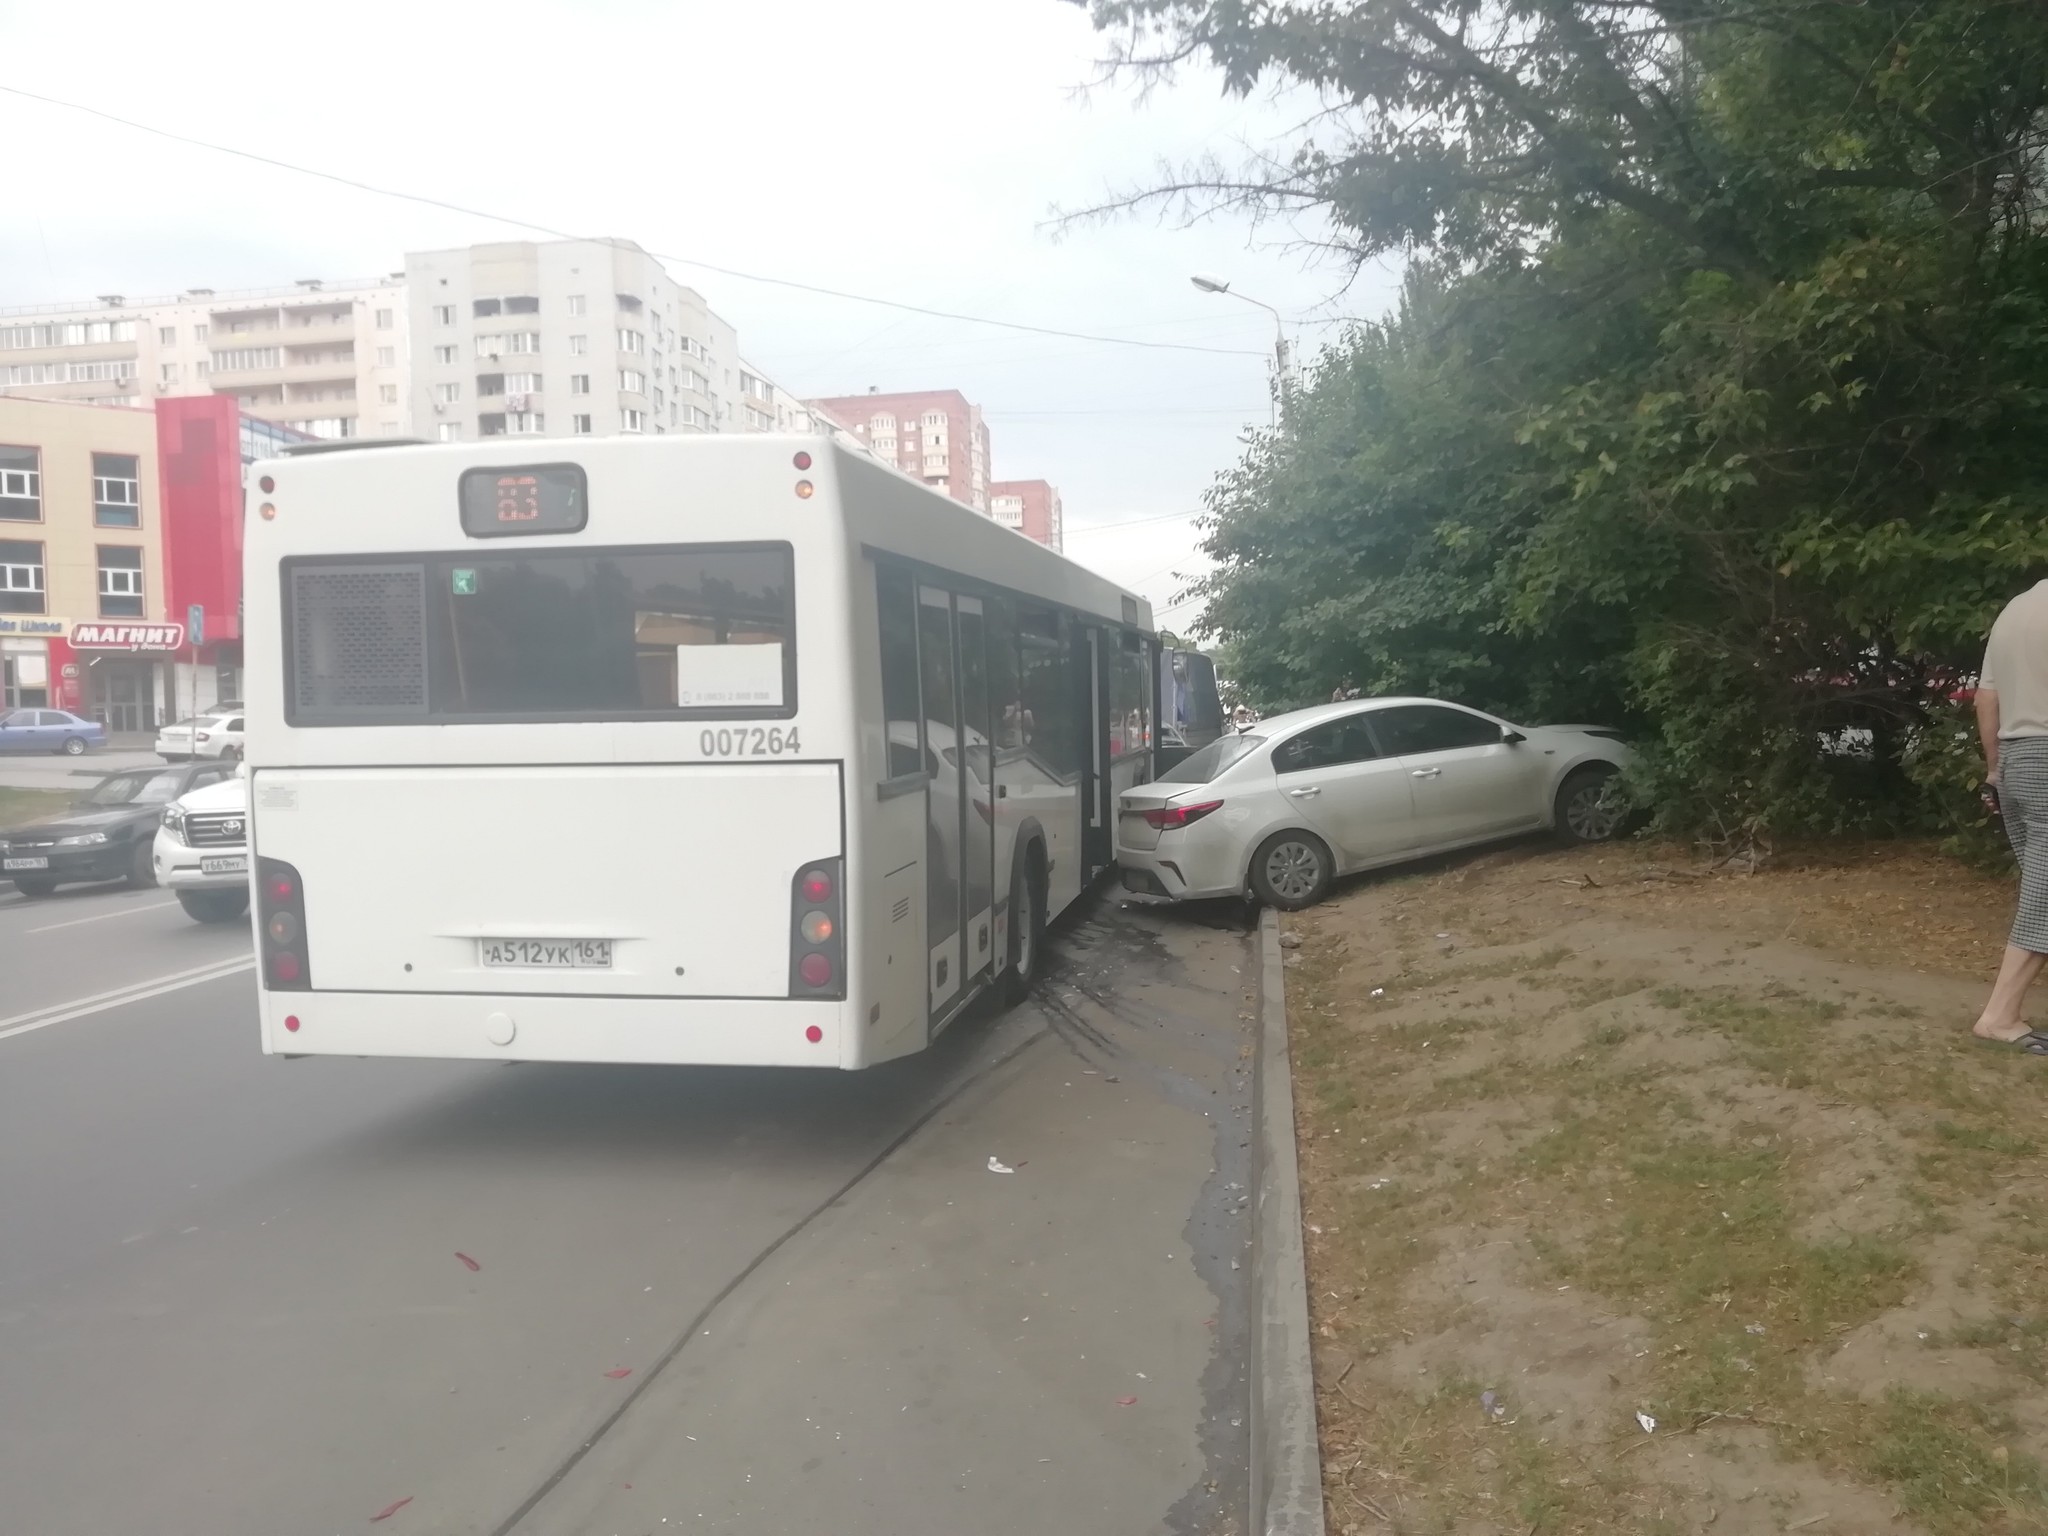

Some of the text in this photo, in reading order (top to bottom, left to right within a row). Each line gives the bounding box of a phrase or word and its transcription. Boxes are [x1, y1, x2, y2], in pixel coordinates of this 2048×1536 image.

[76, 626, 178, 643] МАГНИТ
[700, 726, 801, 757] 007264
[490, 941, 605, 964] А512УК 161
